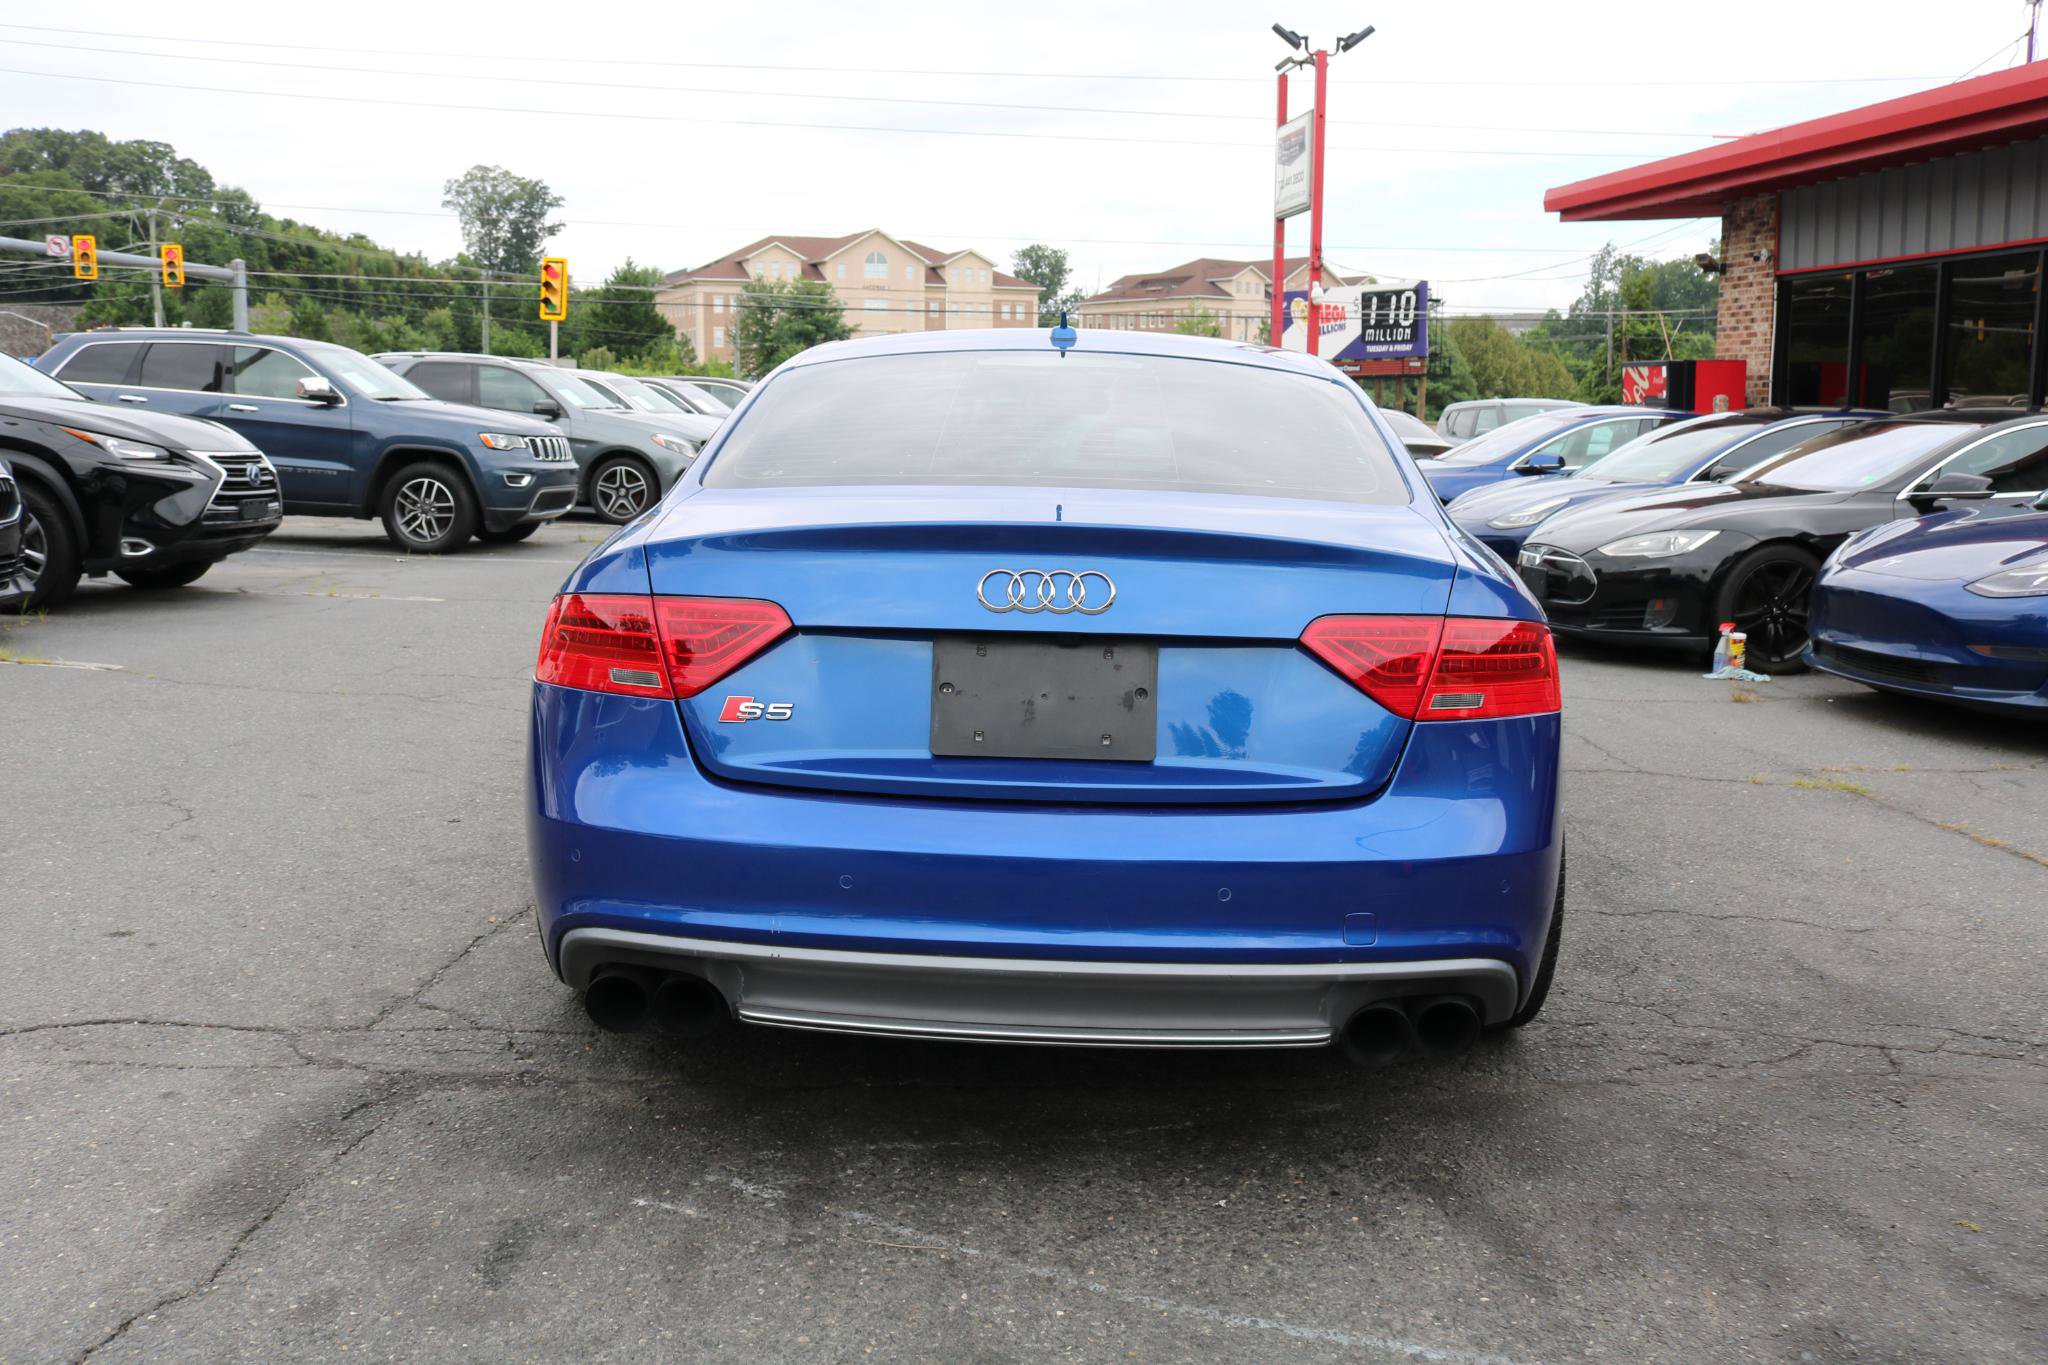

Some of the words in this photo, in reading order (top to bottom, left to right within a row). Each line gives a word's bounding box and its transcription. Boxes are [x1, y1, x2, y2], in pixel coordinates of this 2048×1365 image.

[1369, 291, 1417, 326] 110
[1318, 322, 1347, 336] ILLIONS
[1365, 328, 1412, 341] MILLION
[736, 702, 795, 720] S5
